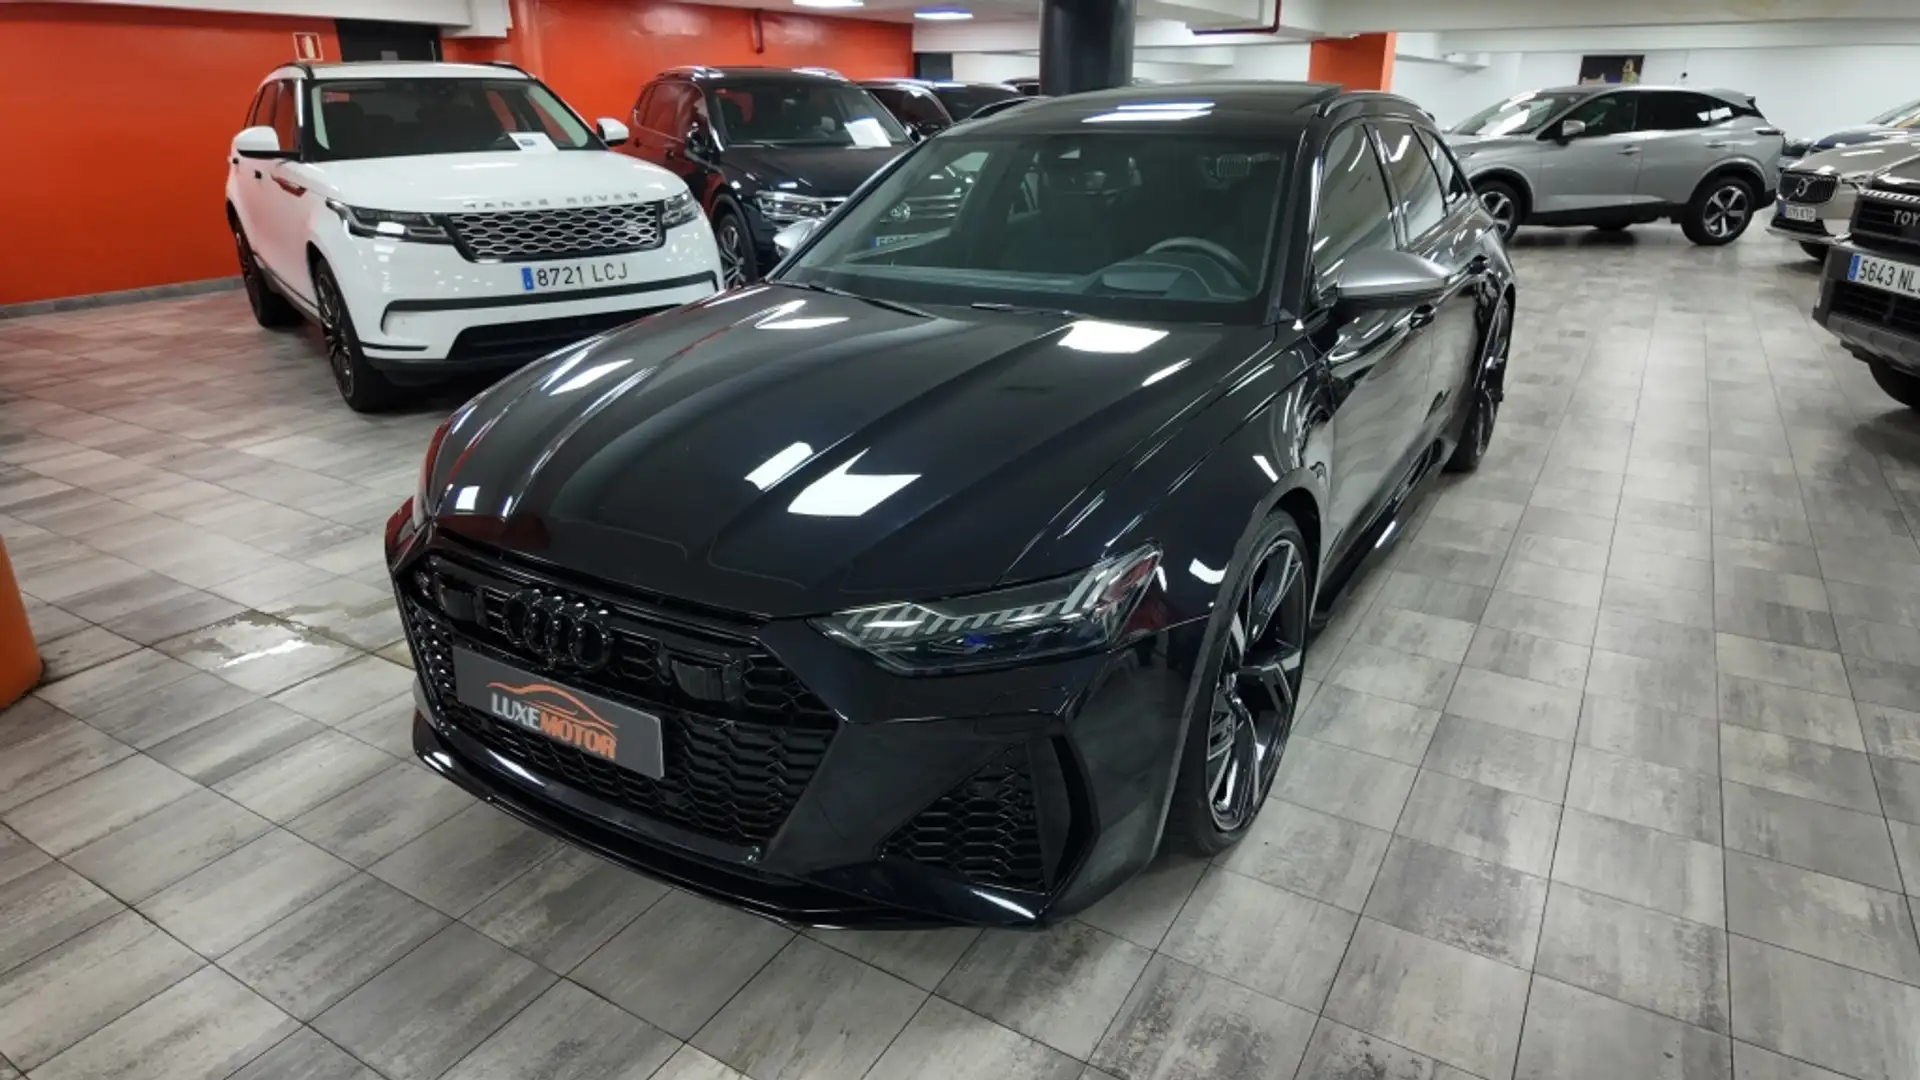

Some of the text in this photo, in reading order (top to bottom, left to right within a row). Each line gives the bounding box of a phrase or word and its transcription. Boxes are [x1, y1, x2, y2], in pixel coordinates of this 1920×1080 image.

[536, 262, 628, 288] 8721 LCJ
[1859, 259, 1920, 294] 5643 NL
